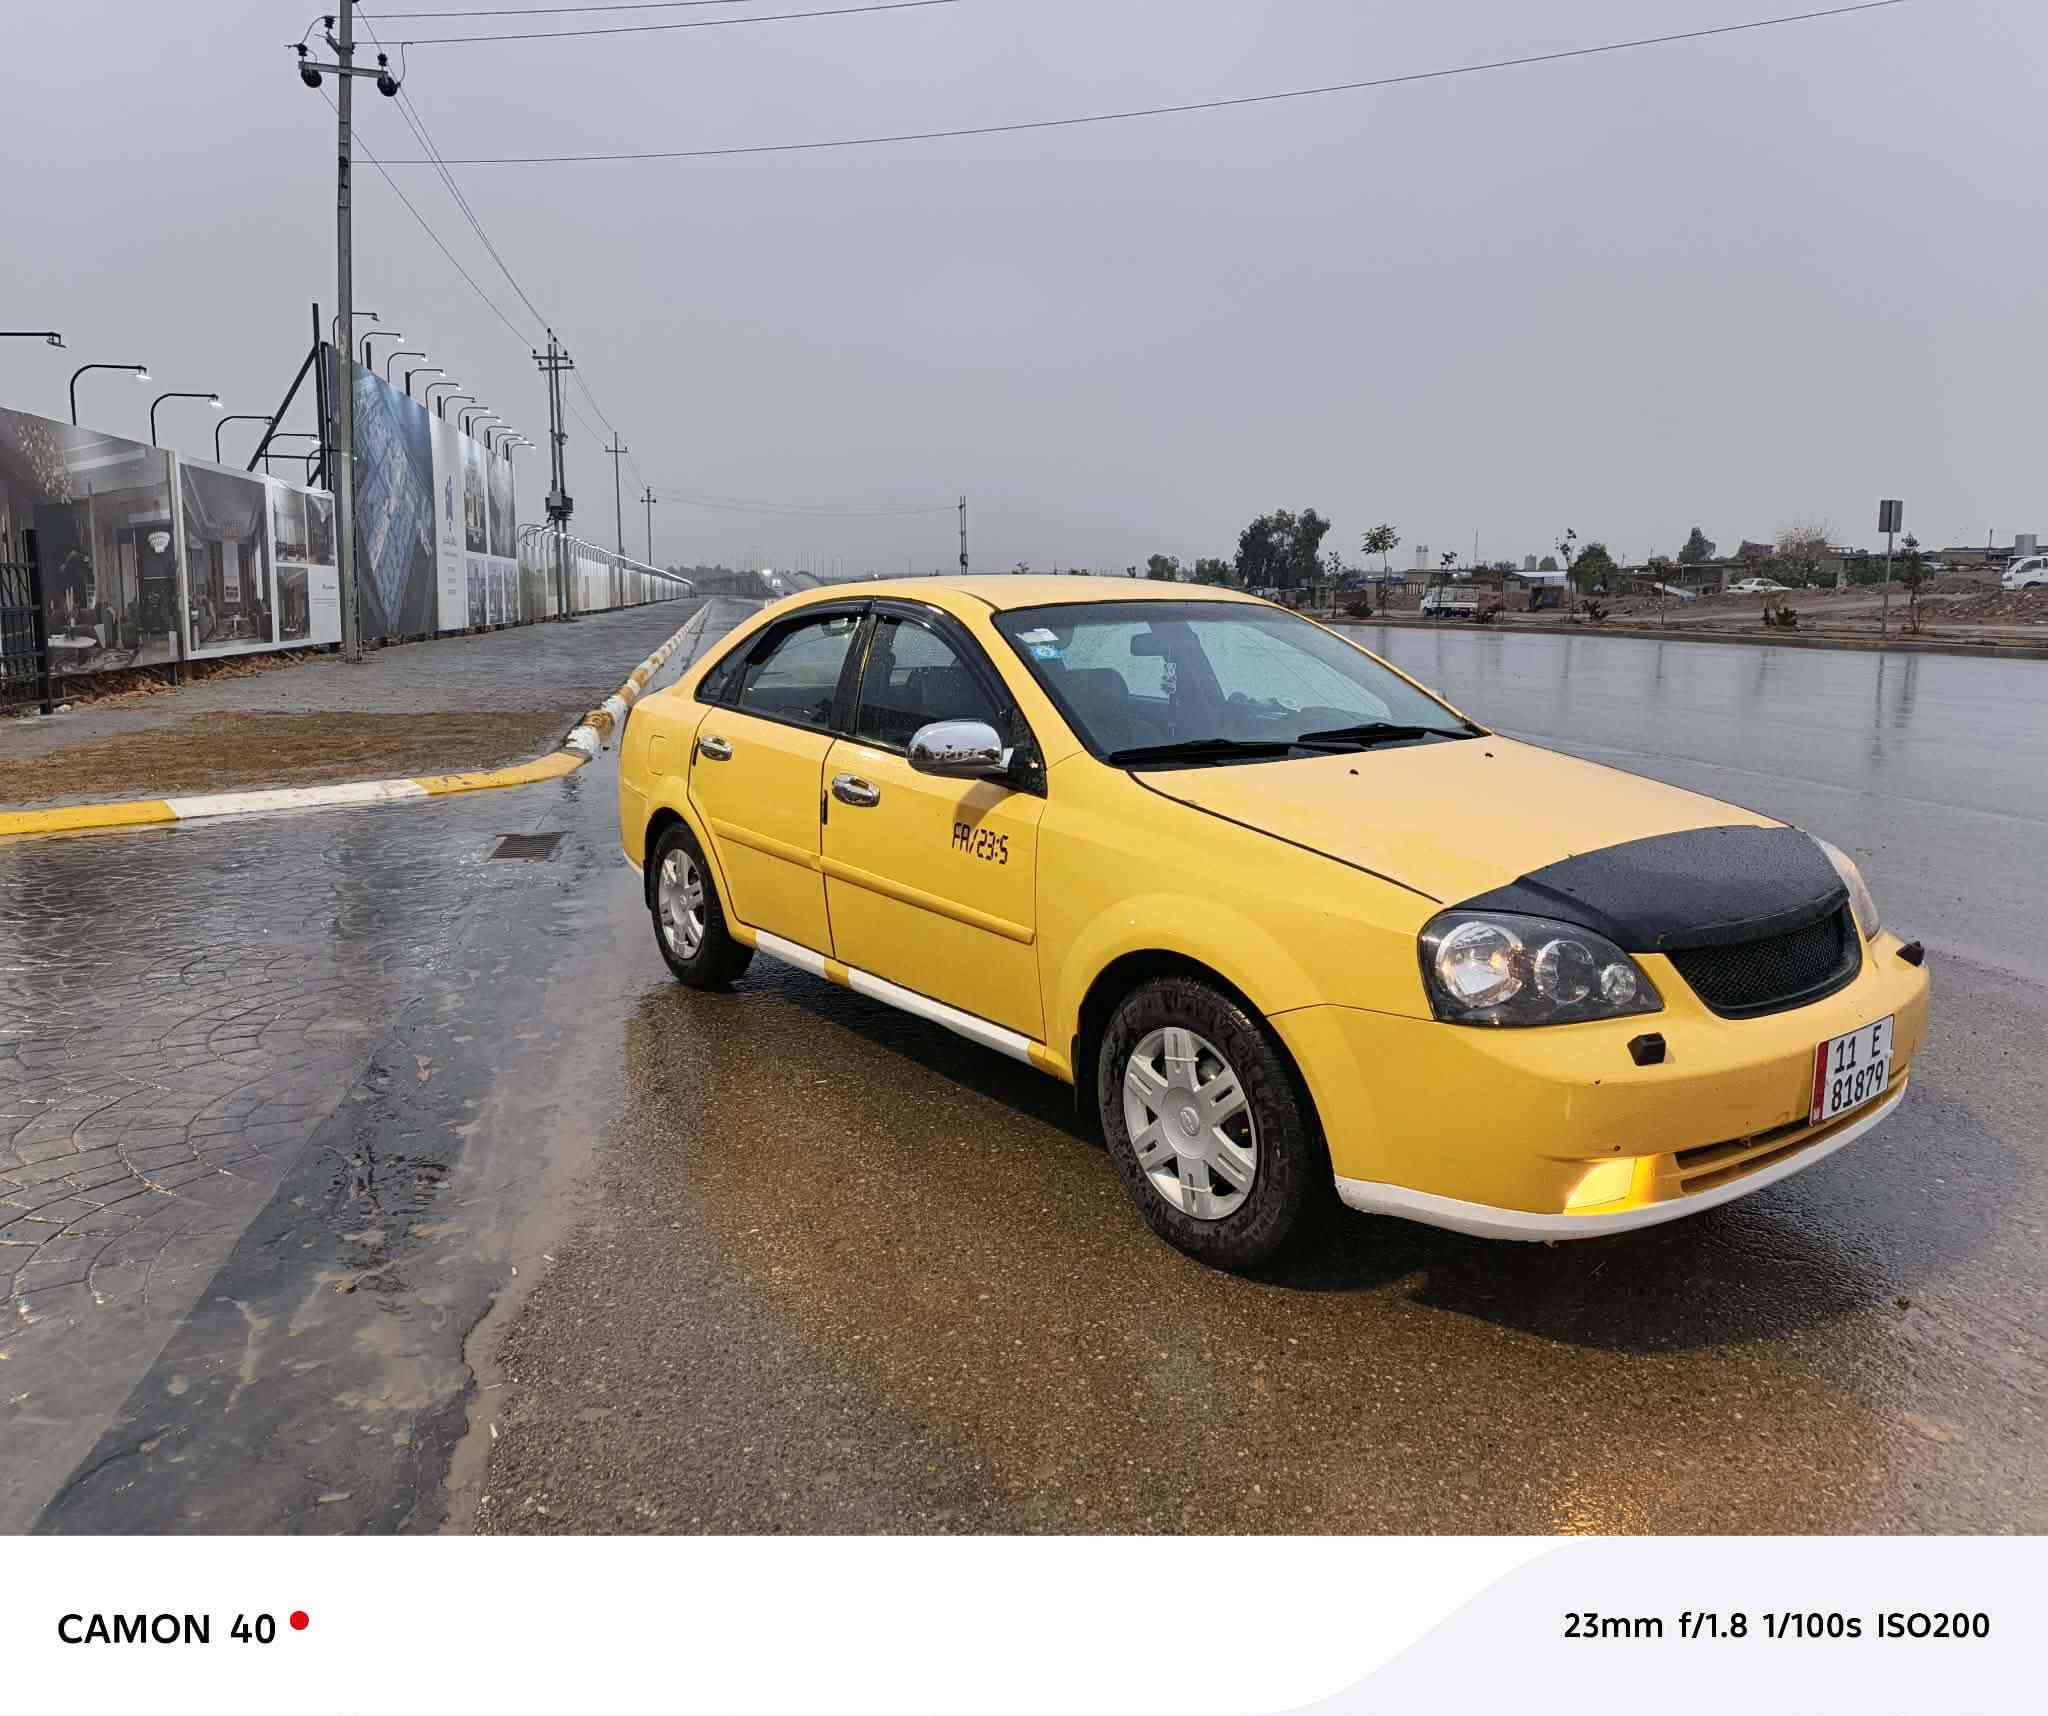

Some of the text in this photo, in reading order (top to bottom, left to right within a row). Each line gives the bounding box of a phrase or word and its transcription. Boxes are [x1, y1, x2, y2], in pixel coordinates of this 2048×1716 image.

[1834, 1024, 1882, 1074] 11 E
[1831, 1059, 1884, 1112] 81879
